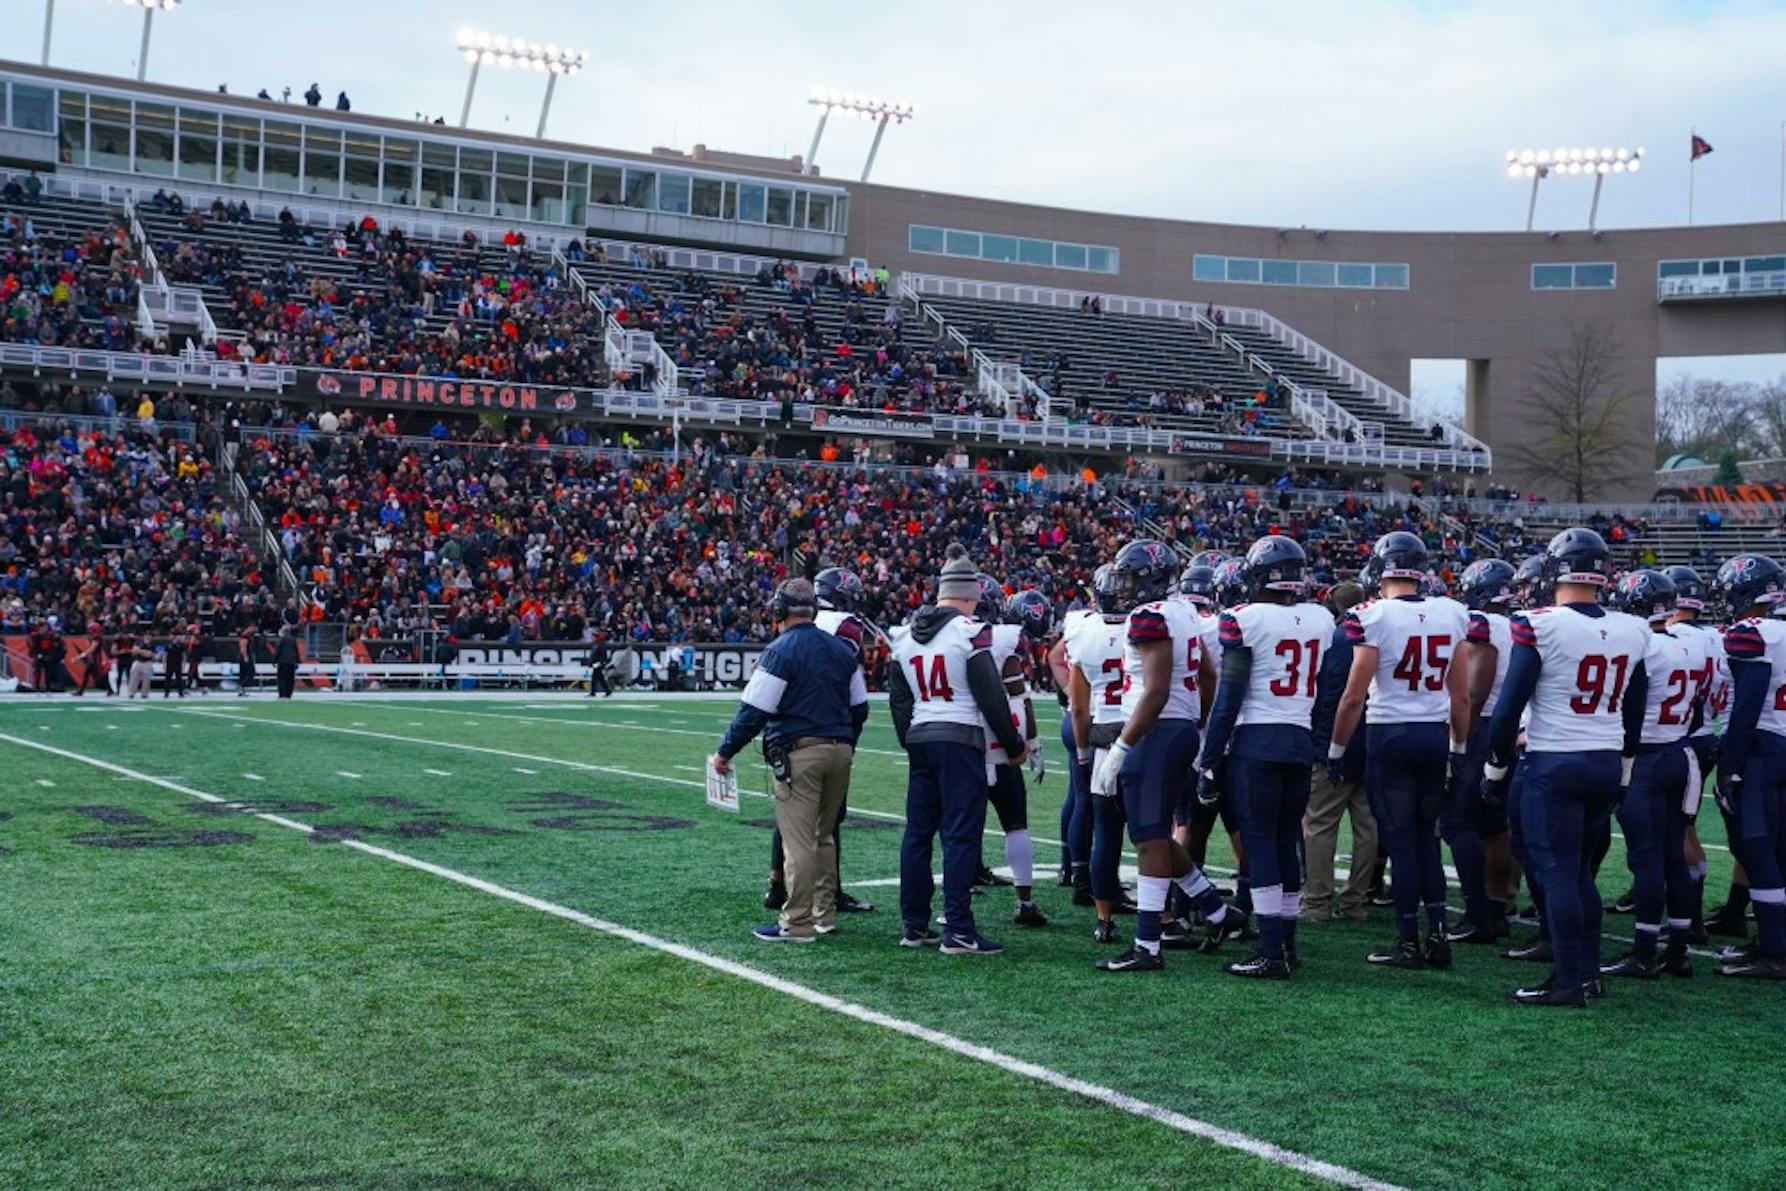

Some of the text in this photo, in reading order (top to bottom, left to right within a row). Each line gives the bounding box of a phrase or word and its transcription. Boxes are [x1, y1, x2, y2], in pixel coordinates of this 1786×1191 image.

[359, 376, 537, 410] PRINCETON
[909, 655, 954, 702] 14
[1270, 639, 1320, 697] 31
[1394, 635, 1452, 691] 45
[1570, 655, 1628, 714] 91
